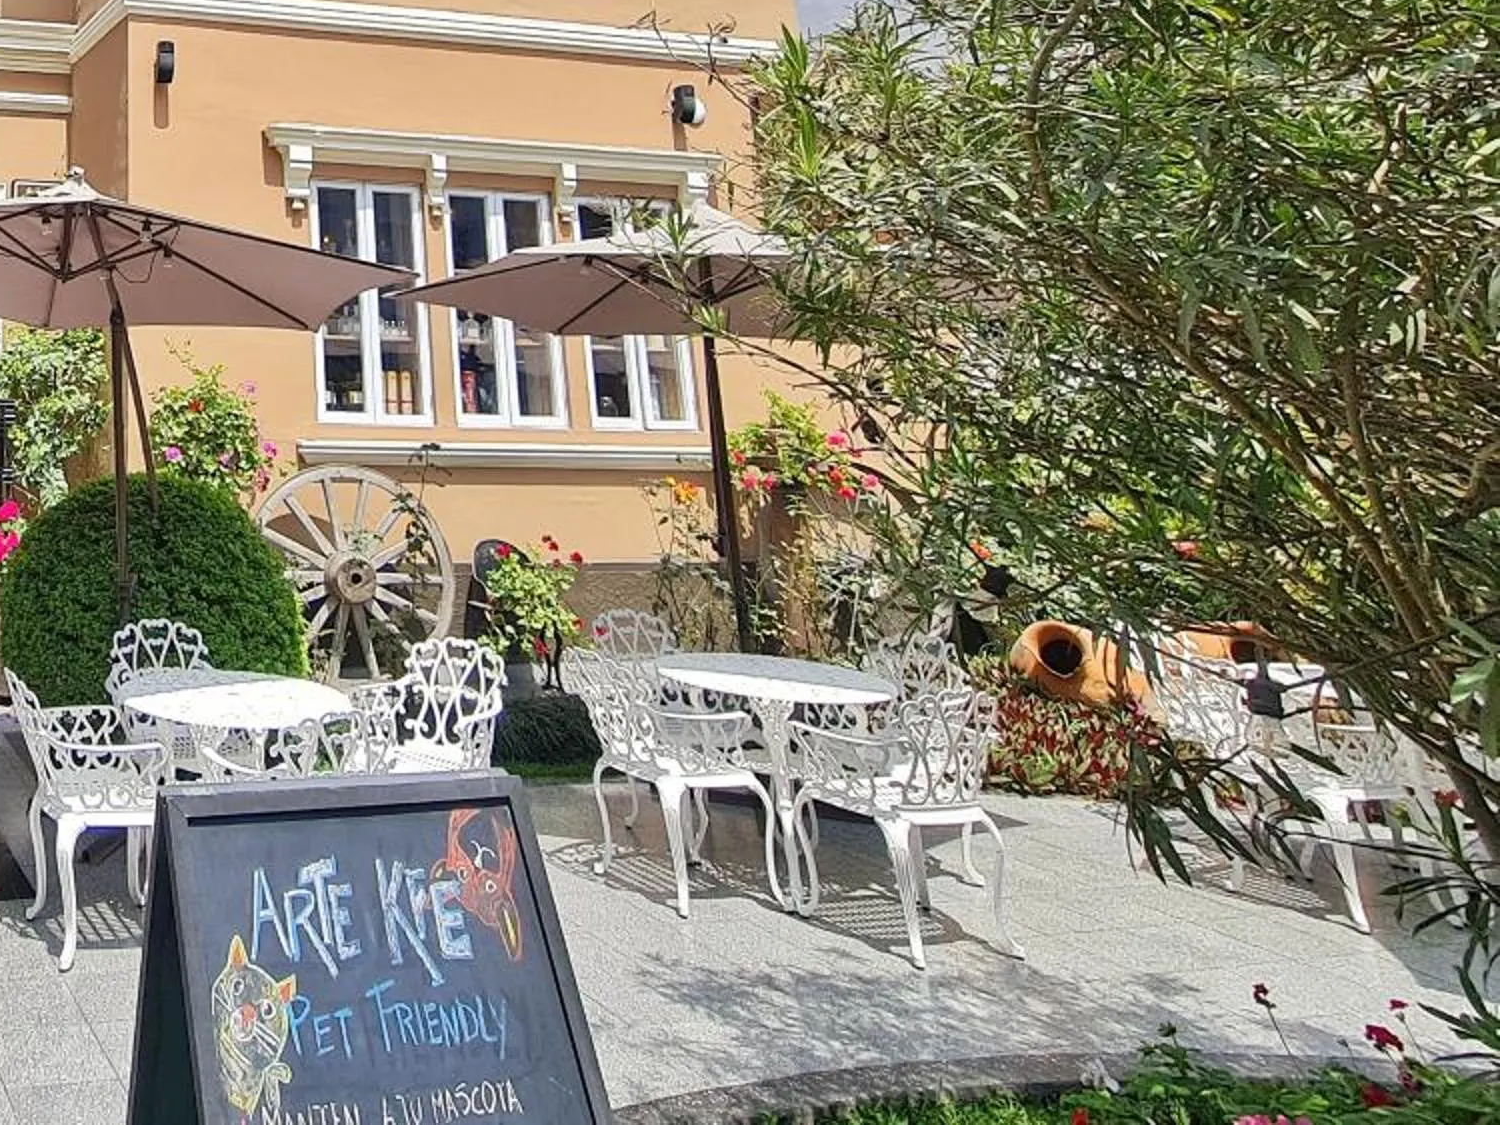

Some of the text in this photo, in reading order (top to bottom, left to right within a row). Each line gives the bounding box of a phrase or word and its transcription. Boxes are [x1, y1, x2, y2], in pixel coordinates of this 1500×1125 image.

[251, 855, 362, 978] ARTE
[285, 979, 506, 1061] PET FRIENDLY
[431, 1078, 524, 1124] MASCOTA
